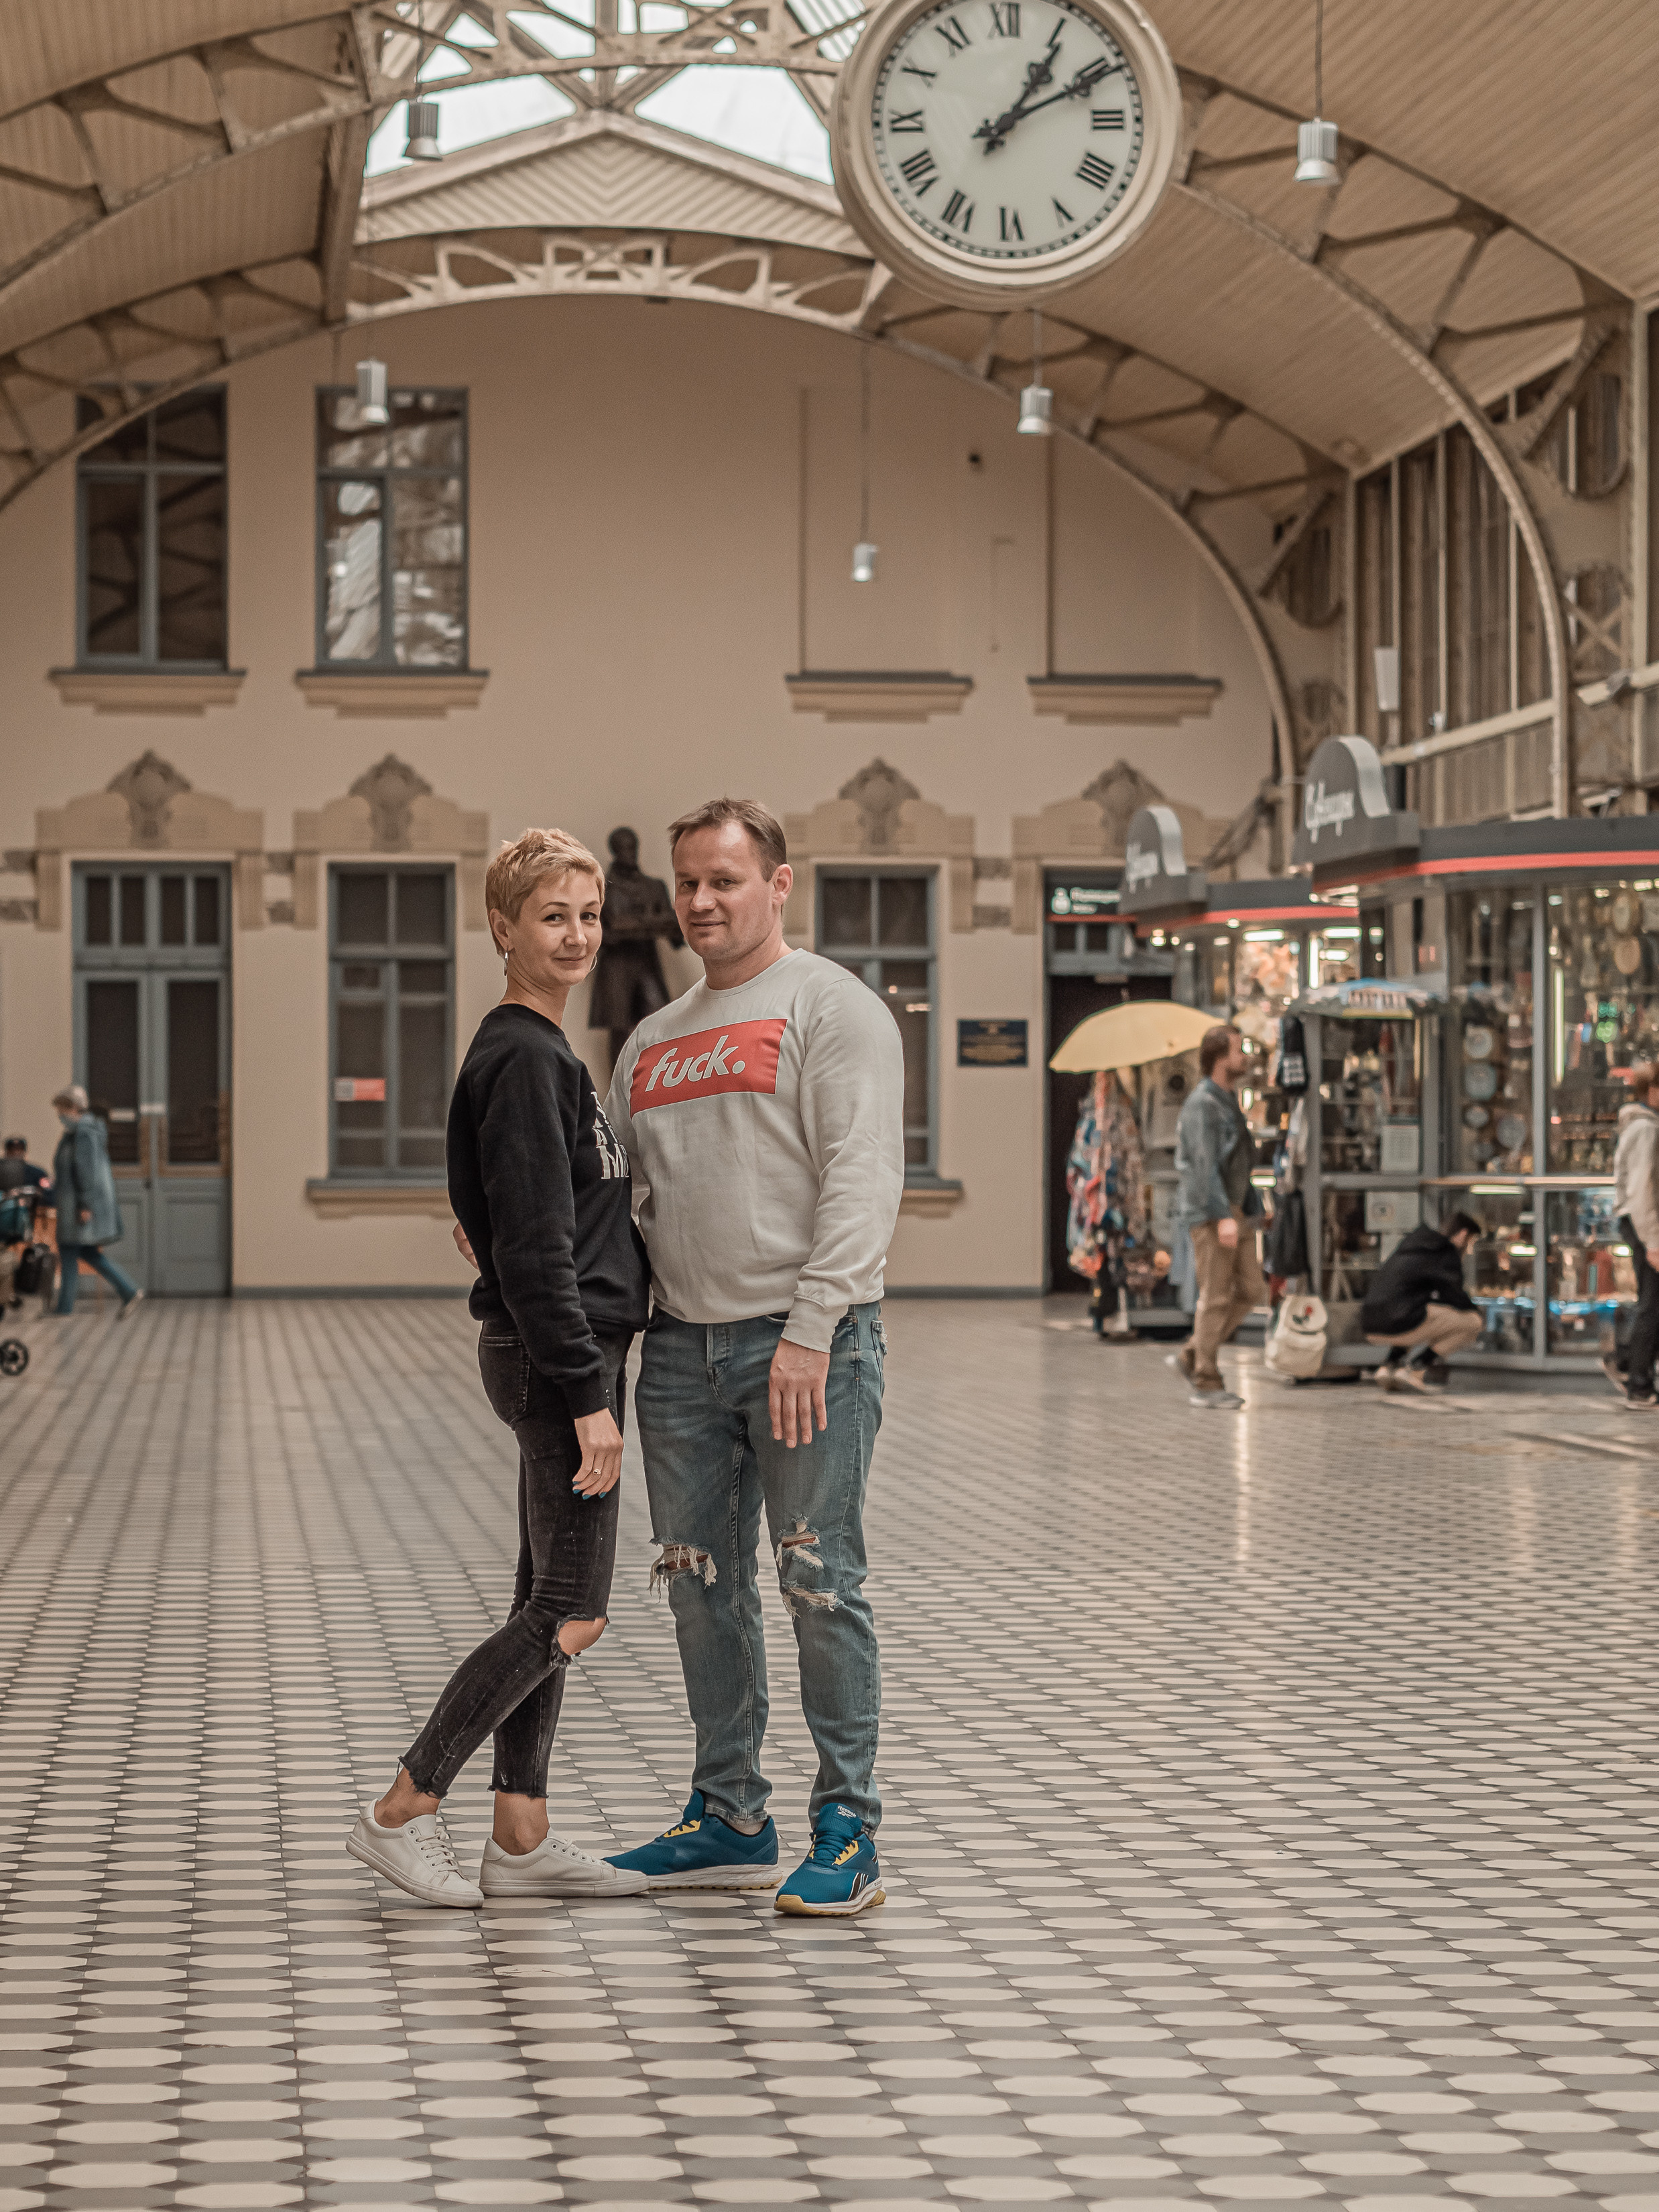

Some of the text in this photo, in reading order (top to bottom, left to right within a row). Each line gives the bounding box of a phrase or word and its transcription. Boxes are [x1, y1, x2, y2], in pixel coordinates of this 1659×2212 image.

[934, 15, 972, 58] XI
[987, 2, 1021, 39] XII
[902, 56, 937, 88] X
[889, 108, 924, 133] IX
[1091, 109, 1125, 131] III
[900, 148, 940, 196] VIII
[1075, 151, 1116, 190] IIII
[940, 189, 975, 235] VII
[998, 205, 1026, 242] VI
[1051, 196, 1074, 229] V
[645, 1034, 746, 1093] fuck.
[837, 1805, 857, 1819] Reebok
